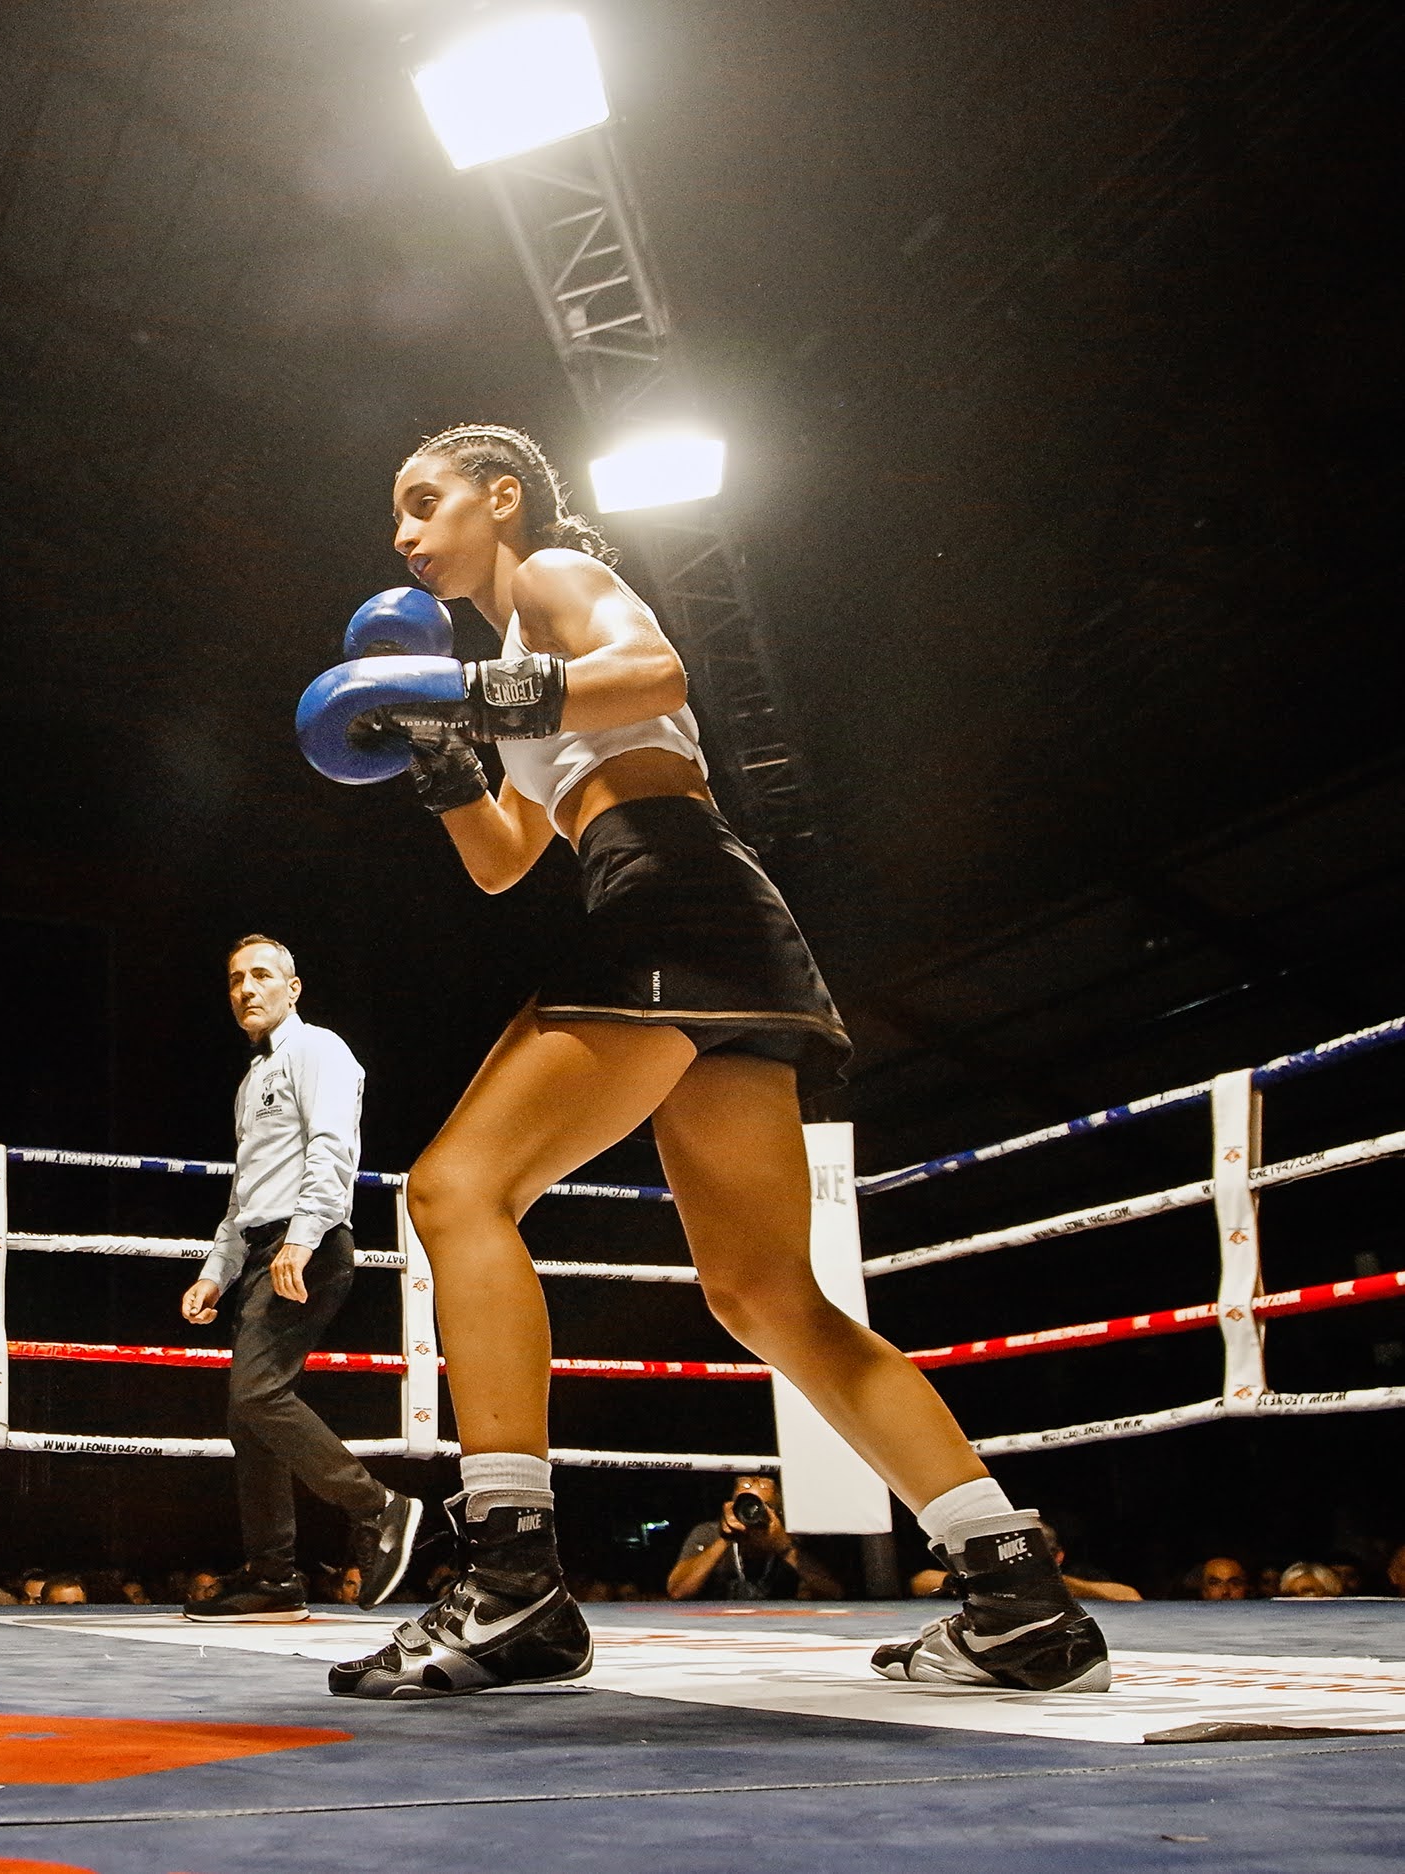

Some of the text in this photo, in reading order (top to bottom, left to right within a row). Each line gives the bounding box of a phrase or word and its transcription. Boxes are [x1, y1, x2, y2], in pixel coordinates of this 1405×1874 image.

[494, 675, 536, 704] LEONE
[652, 970, 661, 1002] KUIKMA
[517, 1513, 542, 1533] NIKE
[997, 1536, 1028, 1562] NIKE
